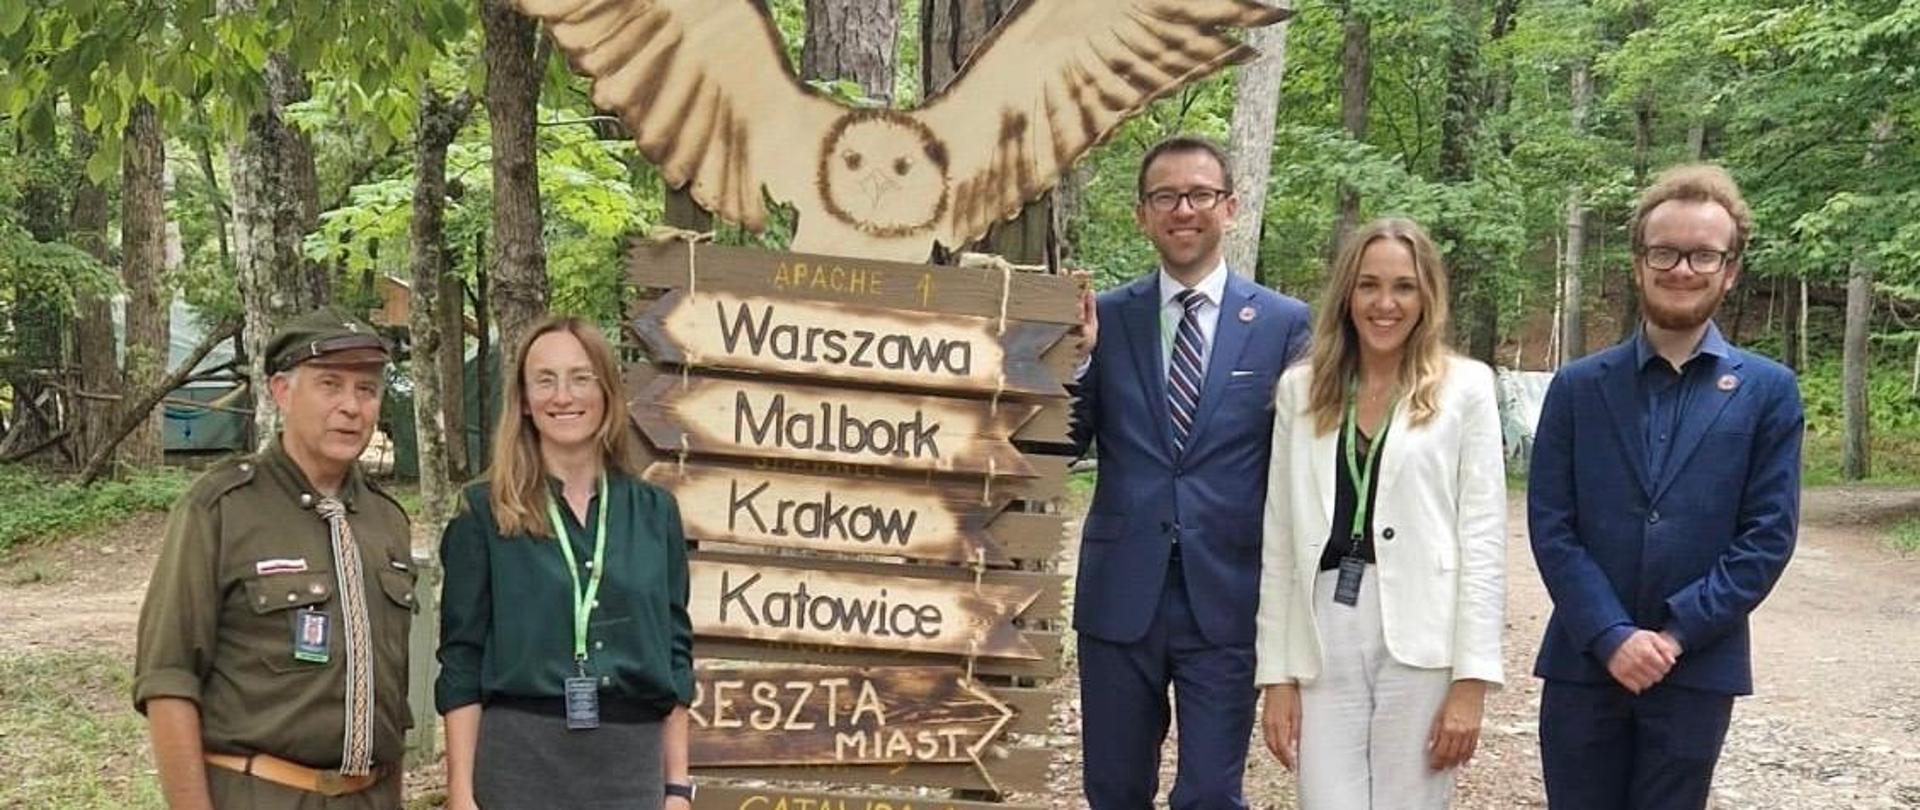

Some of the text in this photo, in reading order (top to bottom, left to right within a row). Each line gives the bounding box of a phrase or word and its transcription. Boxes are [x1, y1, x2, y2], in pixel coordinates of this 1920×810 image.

[773, 261, 883, 295] APACHE
[717, 301, 972, 376] Warszawa
[734, 391, 940, 459] Malbork
[728, 479, 918, 546] Krakow
[719, 570, 942, 639] Katowice
[835, 729, 967, 760] MIAST
